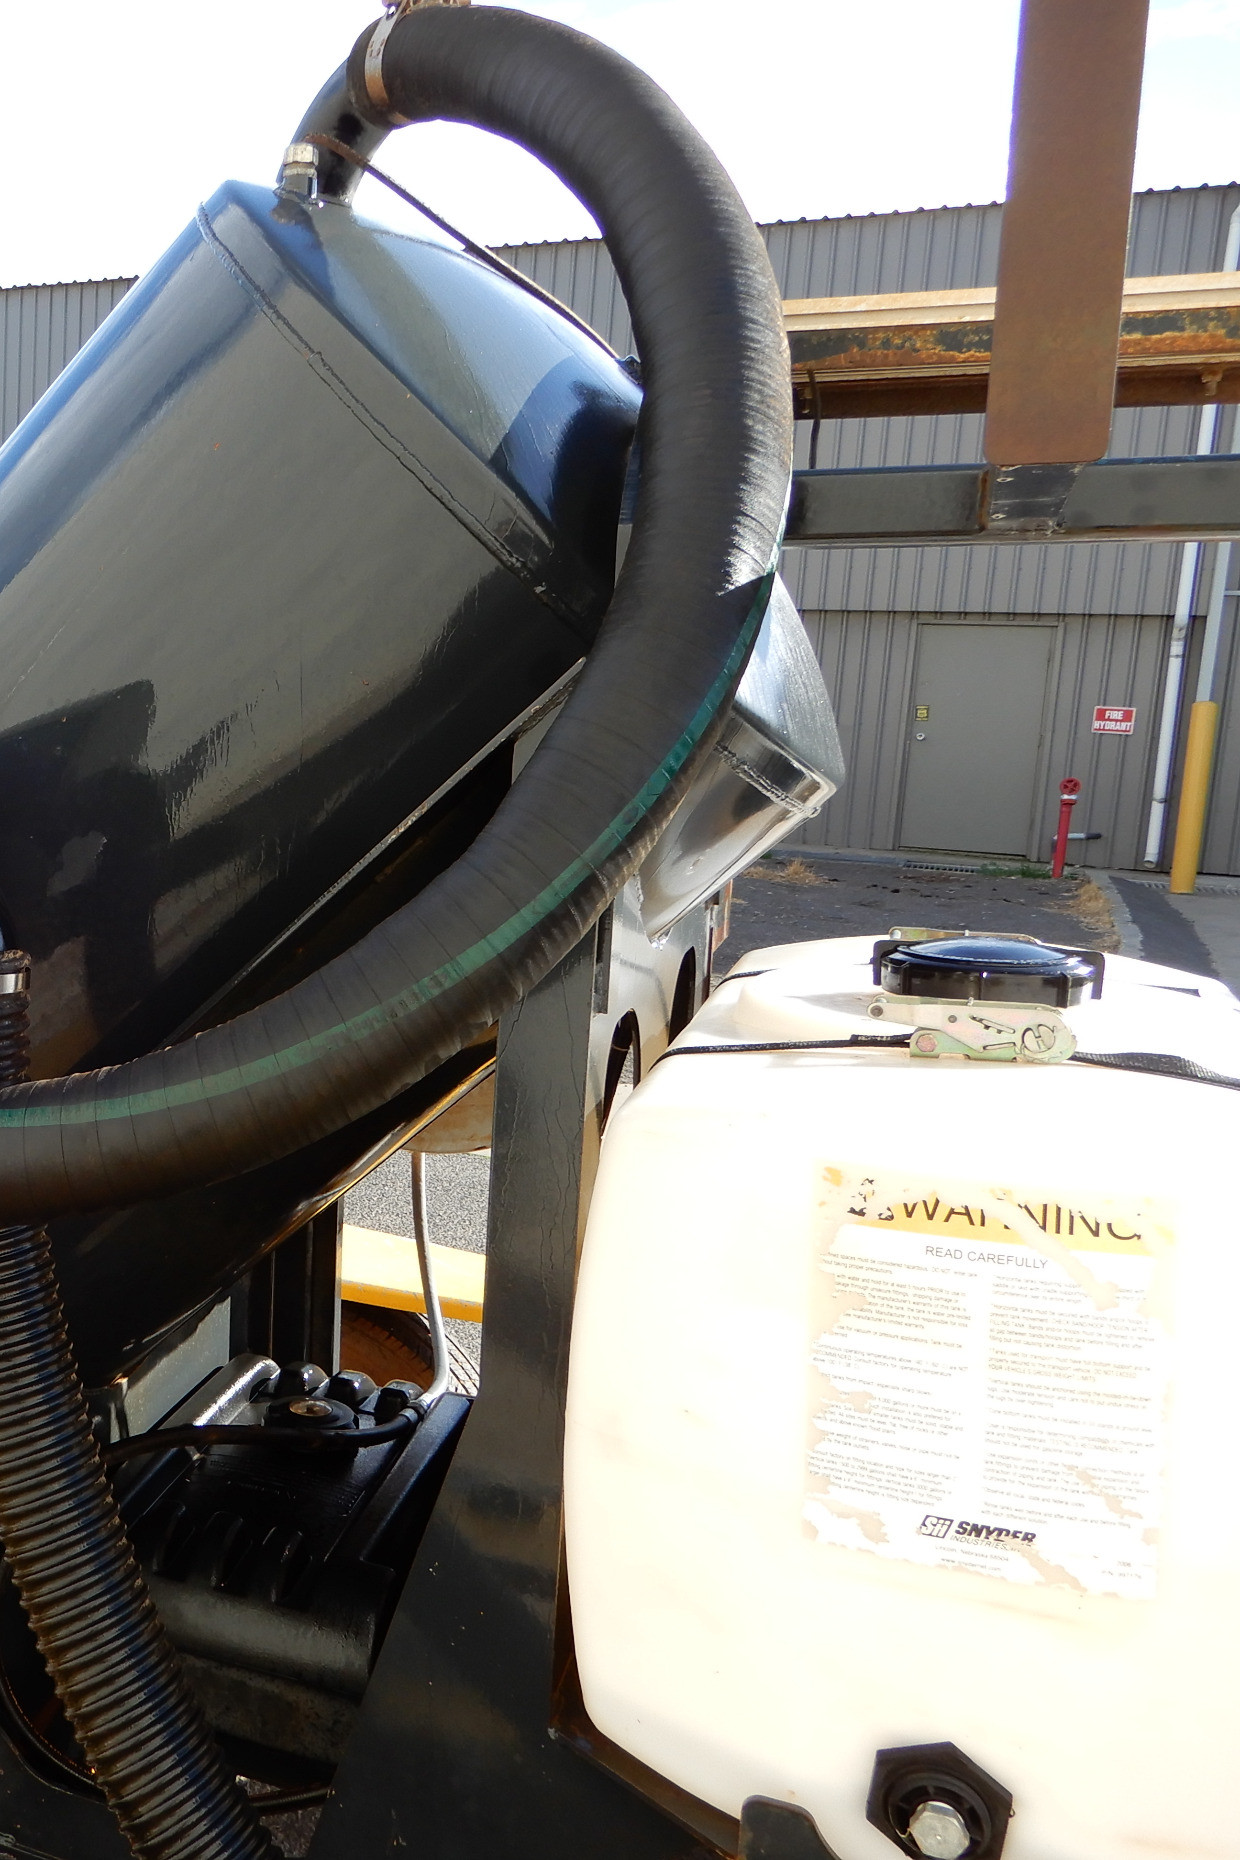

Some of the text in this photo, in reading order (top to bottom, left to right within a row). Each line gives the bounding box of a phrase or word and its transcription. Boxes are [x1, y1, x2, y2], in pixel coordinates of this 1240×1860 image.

[1105, 711, 1124, 720] FIRE
[1094, 721, 1132, 731] HYDRANT
[925, 1245, 1048, 1270] READ CAREFULLY
